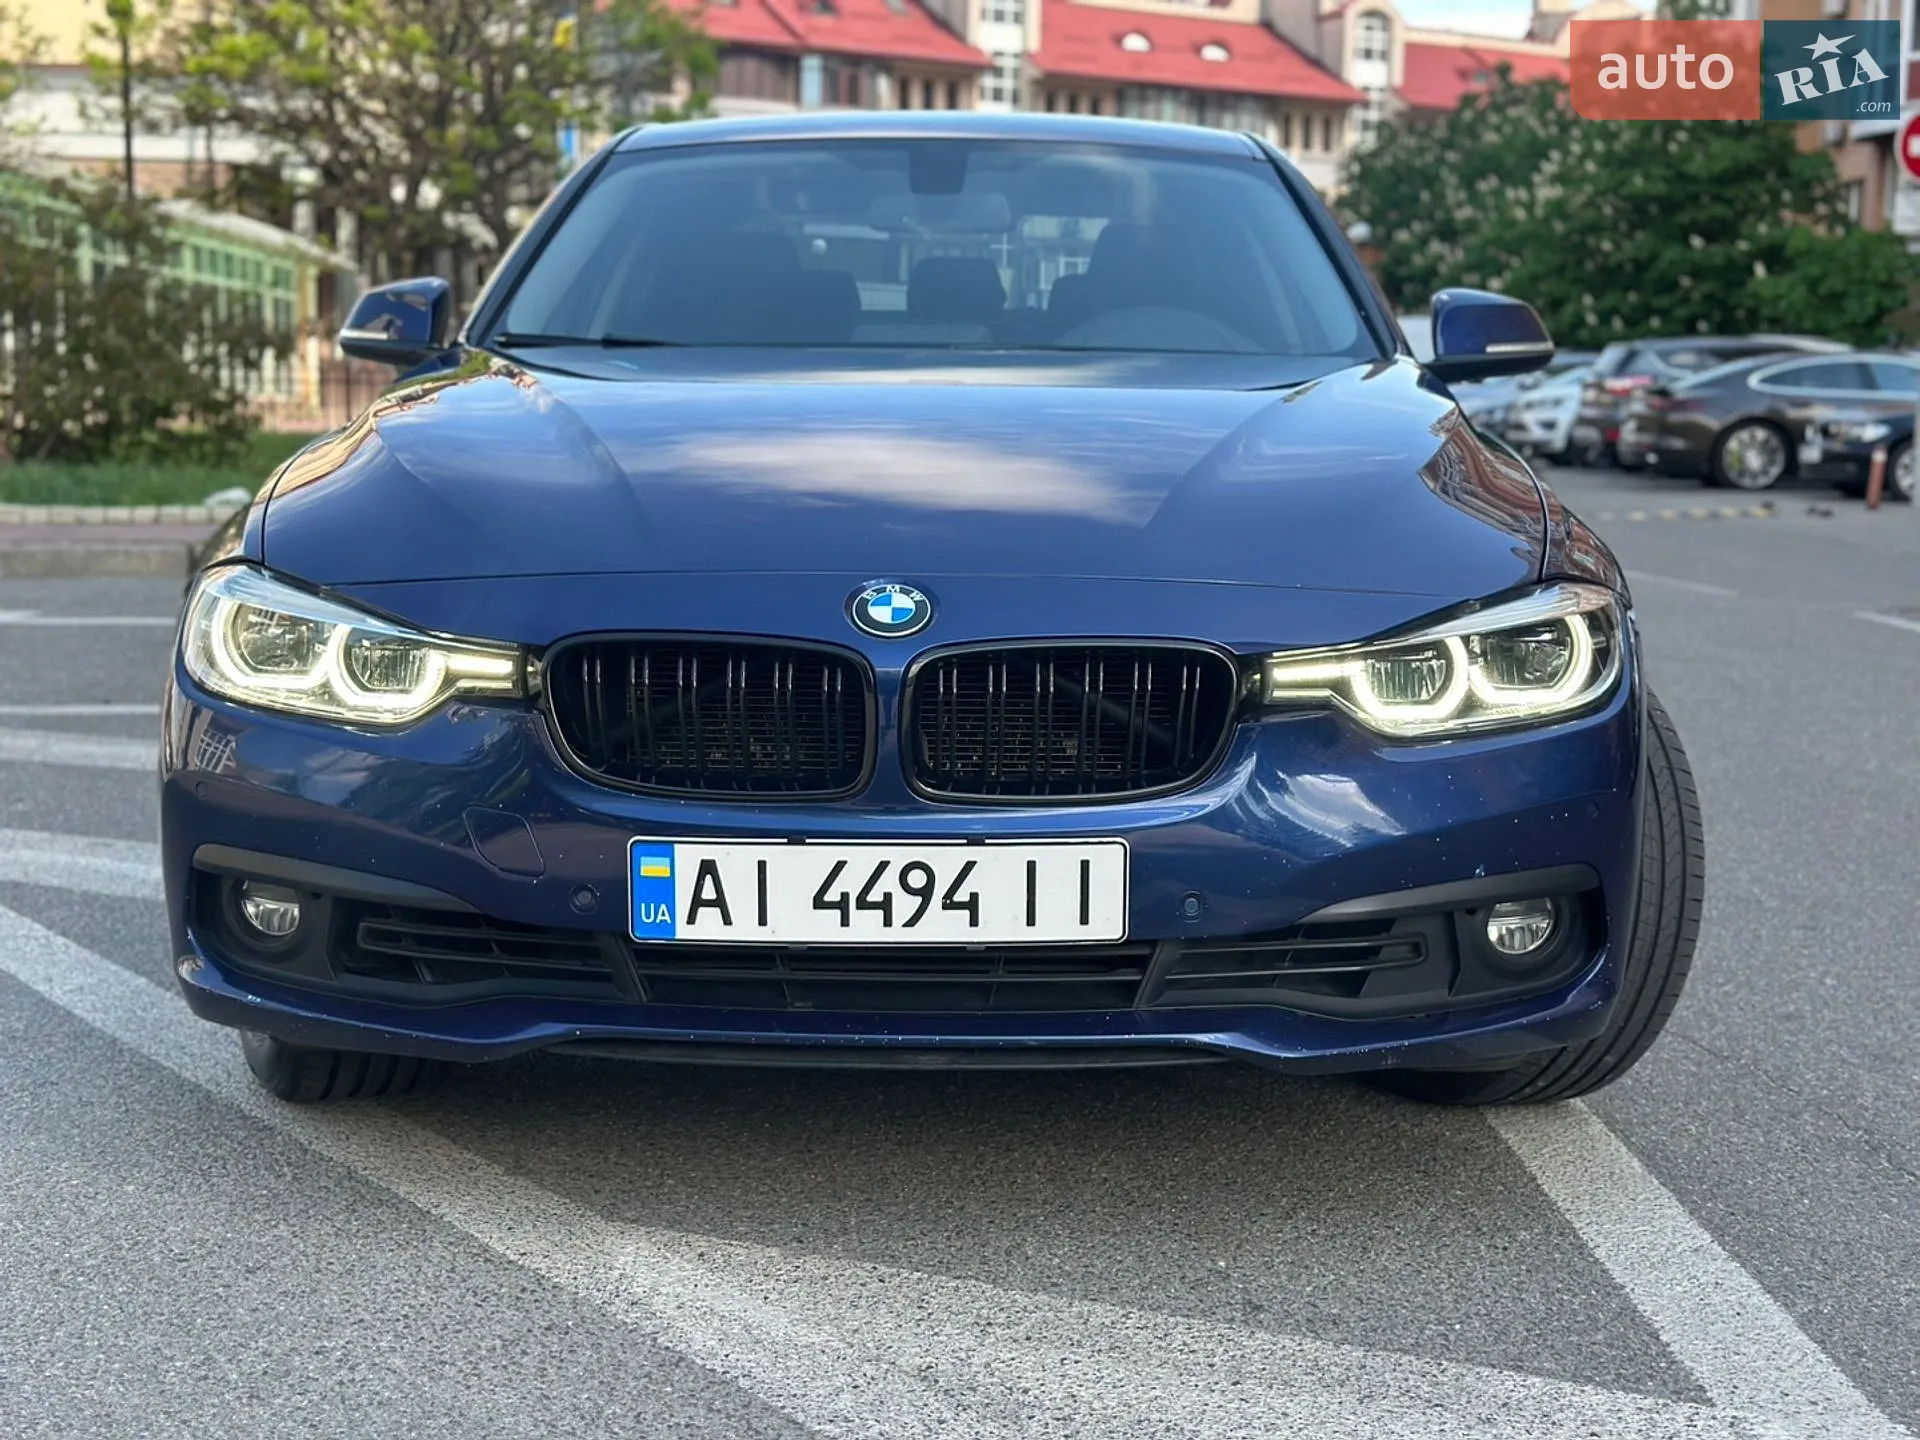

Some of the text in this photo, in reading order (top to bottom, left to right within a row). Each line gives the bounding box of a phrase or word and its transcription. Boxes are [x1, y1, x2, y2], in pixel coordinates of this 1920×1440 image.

[641, 902, 672, 925] UA
[685, 858, 768, 927] AI
[812, 859, 980, 928] 4494
